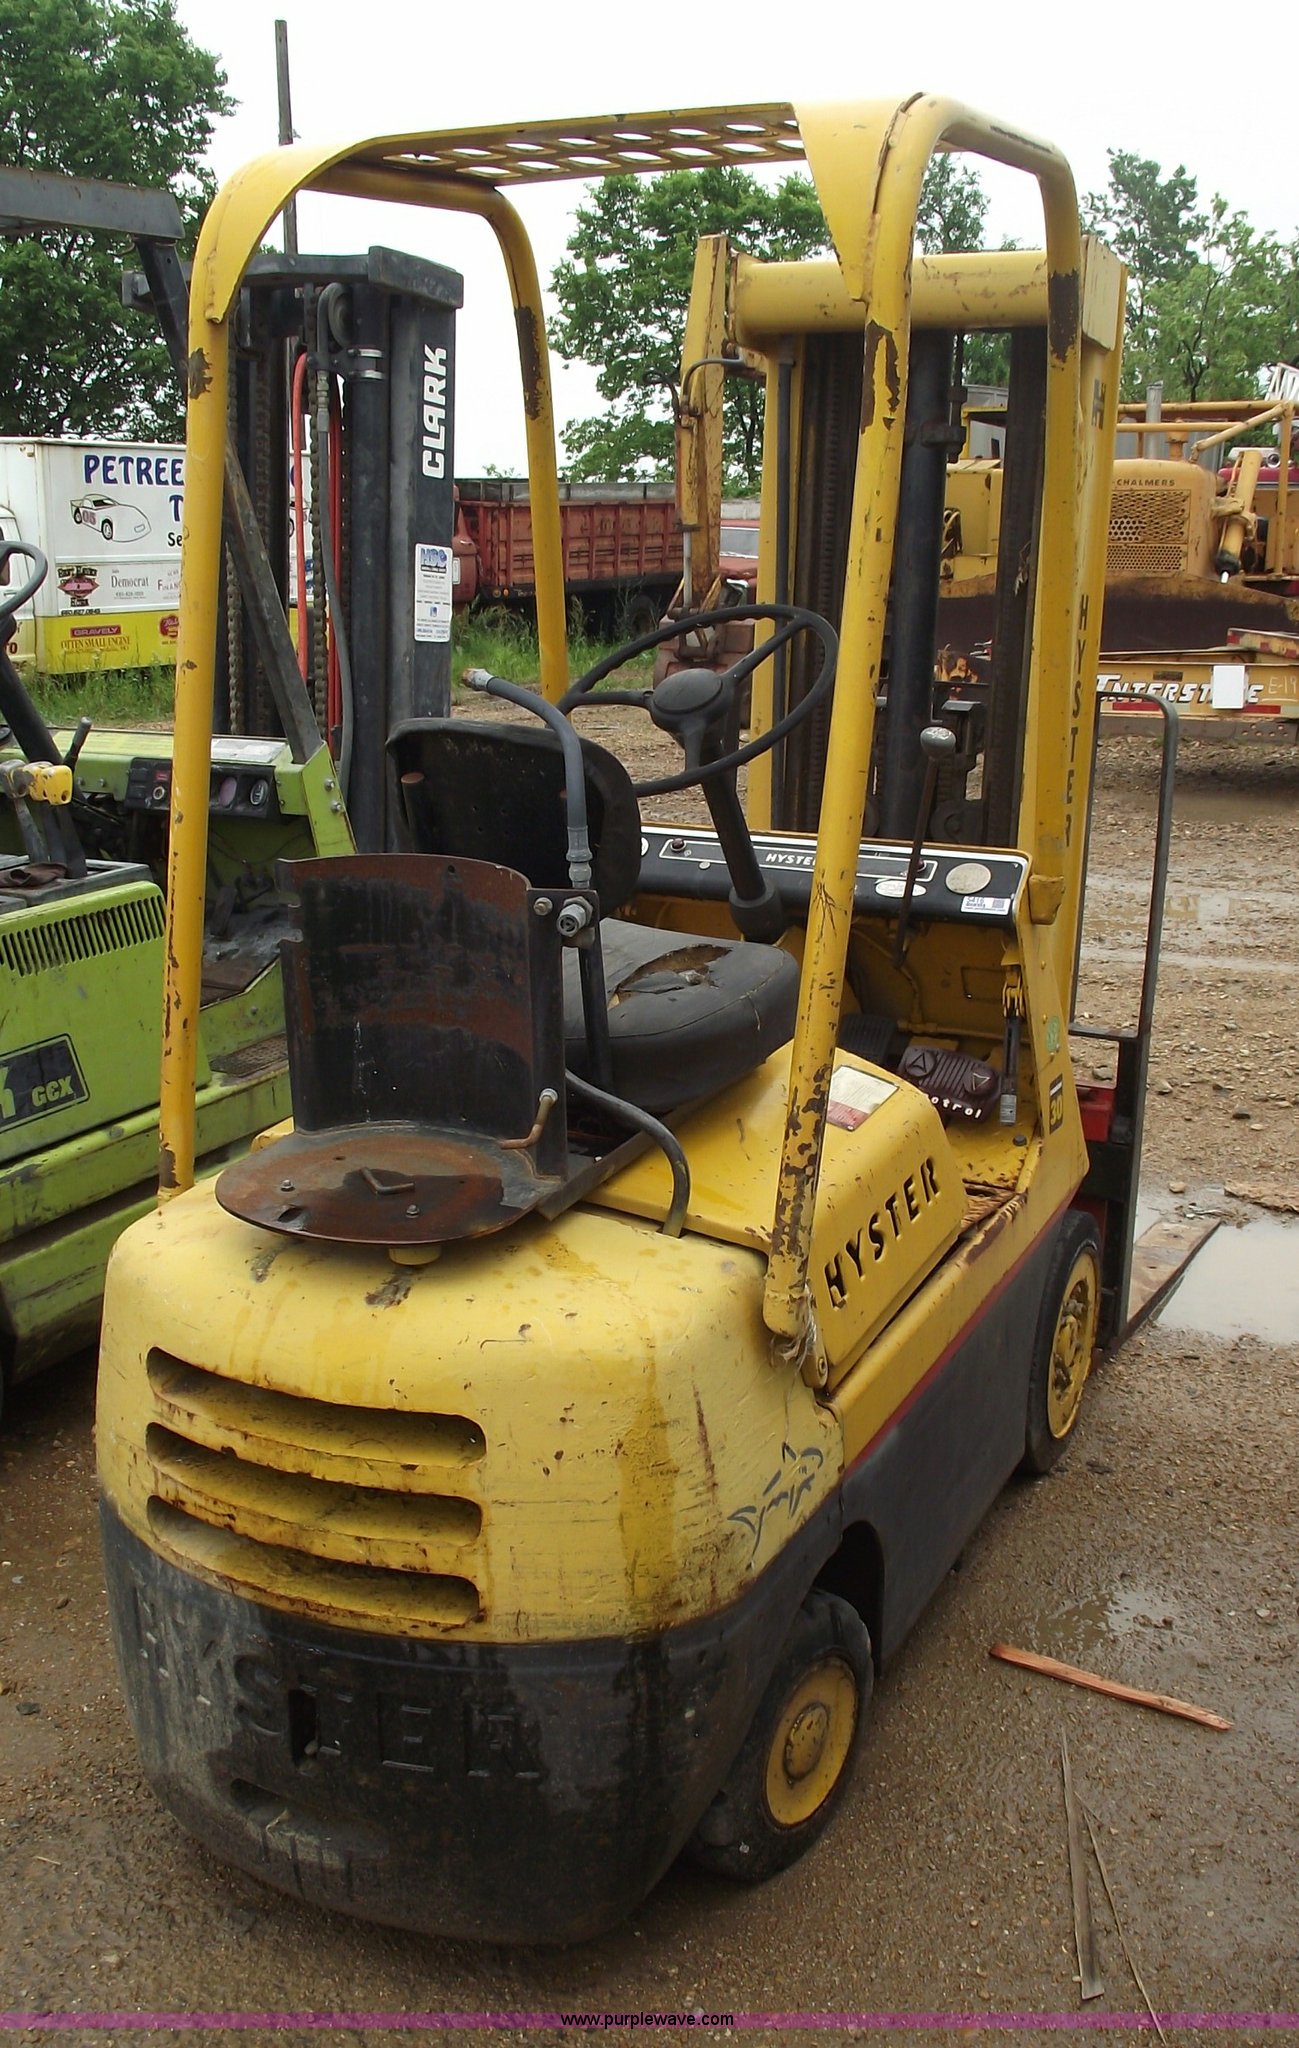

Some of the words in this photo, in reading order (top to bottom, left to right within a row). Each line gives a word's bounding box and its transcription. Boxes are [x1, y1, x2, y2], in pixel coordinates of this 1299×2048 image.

[422, 344, 447, 479] CLARK
[84, 454, 184, 485] PETREE
[82, 510, 97, 525] 05
[111, 575, 149, 588] Democrat
[74, 628, 118, 636] GRAVELY
[84, 638, 106, 648] SMALL
[1050, 1098, 1062, 1126] 30
[823, 1157, 942, 1311] HYSTER
